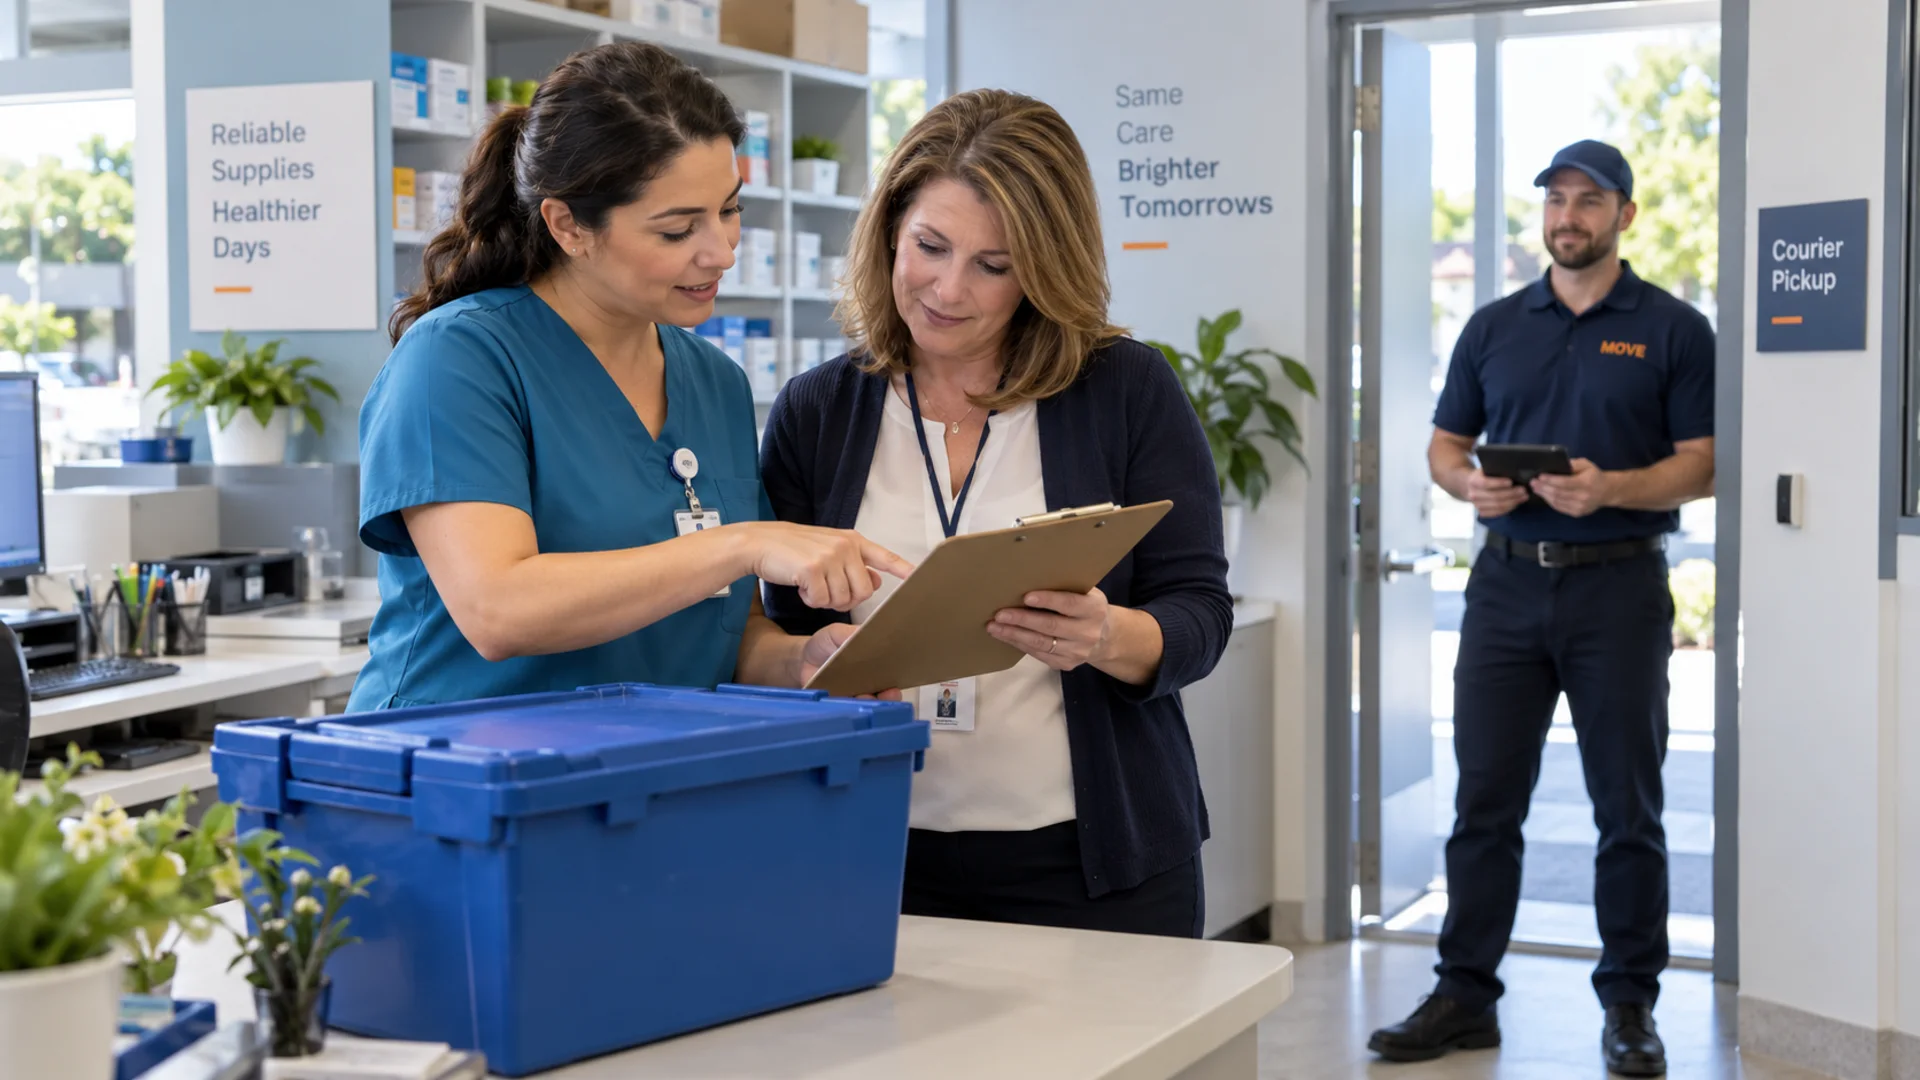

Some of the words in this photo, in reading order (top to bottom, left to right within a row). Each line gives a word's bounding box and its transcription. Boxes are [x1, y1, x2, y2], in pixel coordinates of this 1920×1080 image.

[1115, 84, 1184, 108] Same
[211, 120, 306, 146] Reliable
[1116, 121, 1174, 145] Care
[212, 157, 315, 186] Supplies
[1118, 157, 1220, 187] Brighter
[212, 198, 322, 223] Healthier
[1119, 194, 1274, 218] Tomorrows
[213, 236, 271, 264] Days
[1772, 236, 1844, 262] Courier
[1772, 268, 1837, 295] Pickup
[1600, 339, 1647, 358] MOVE
